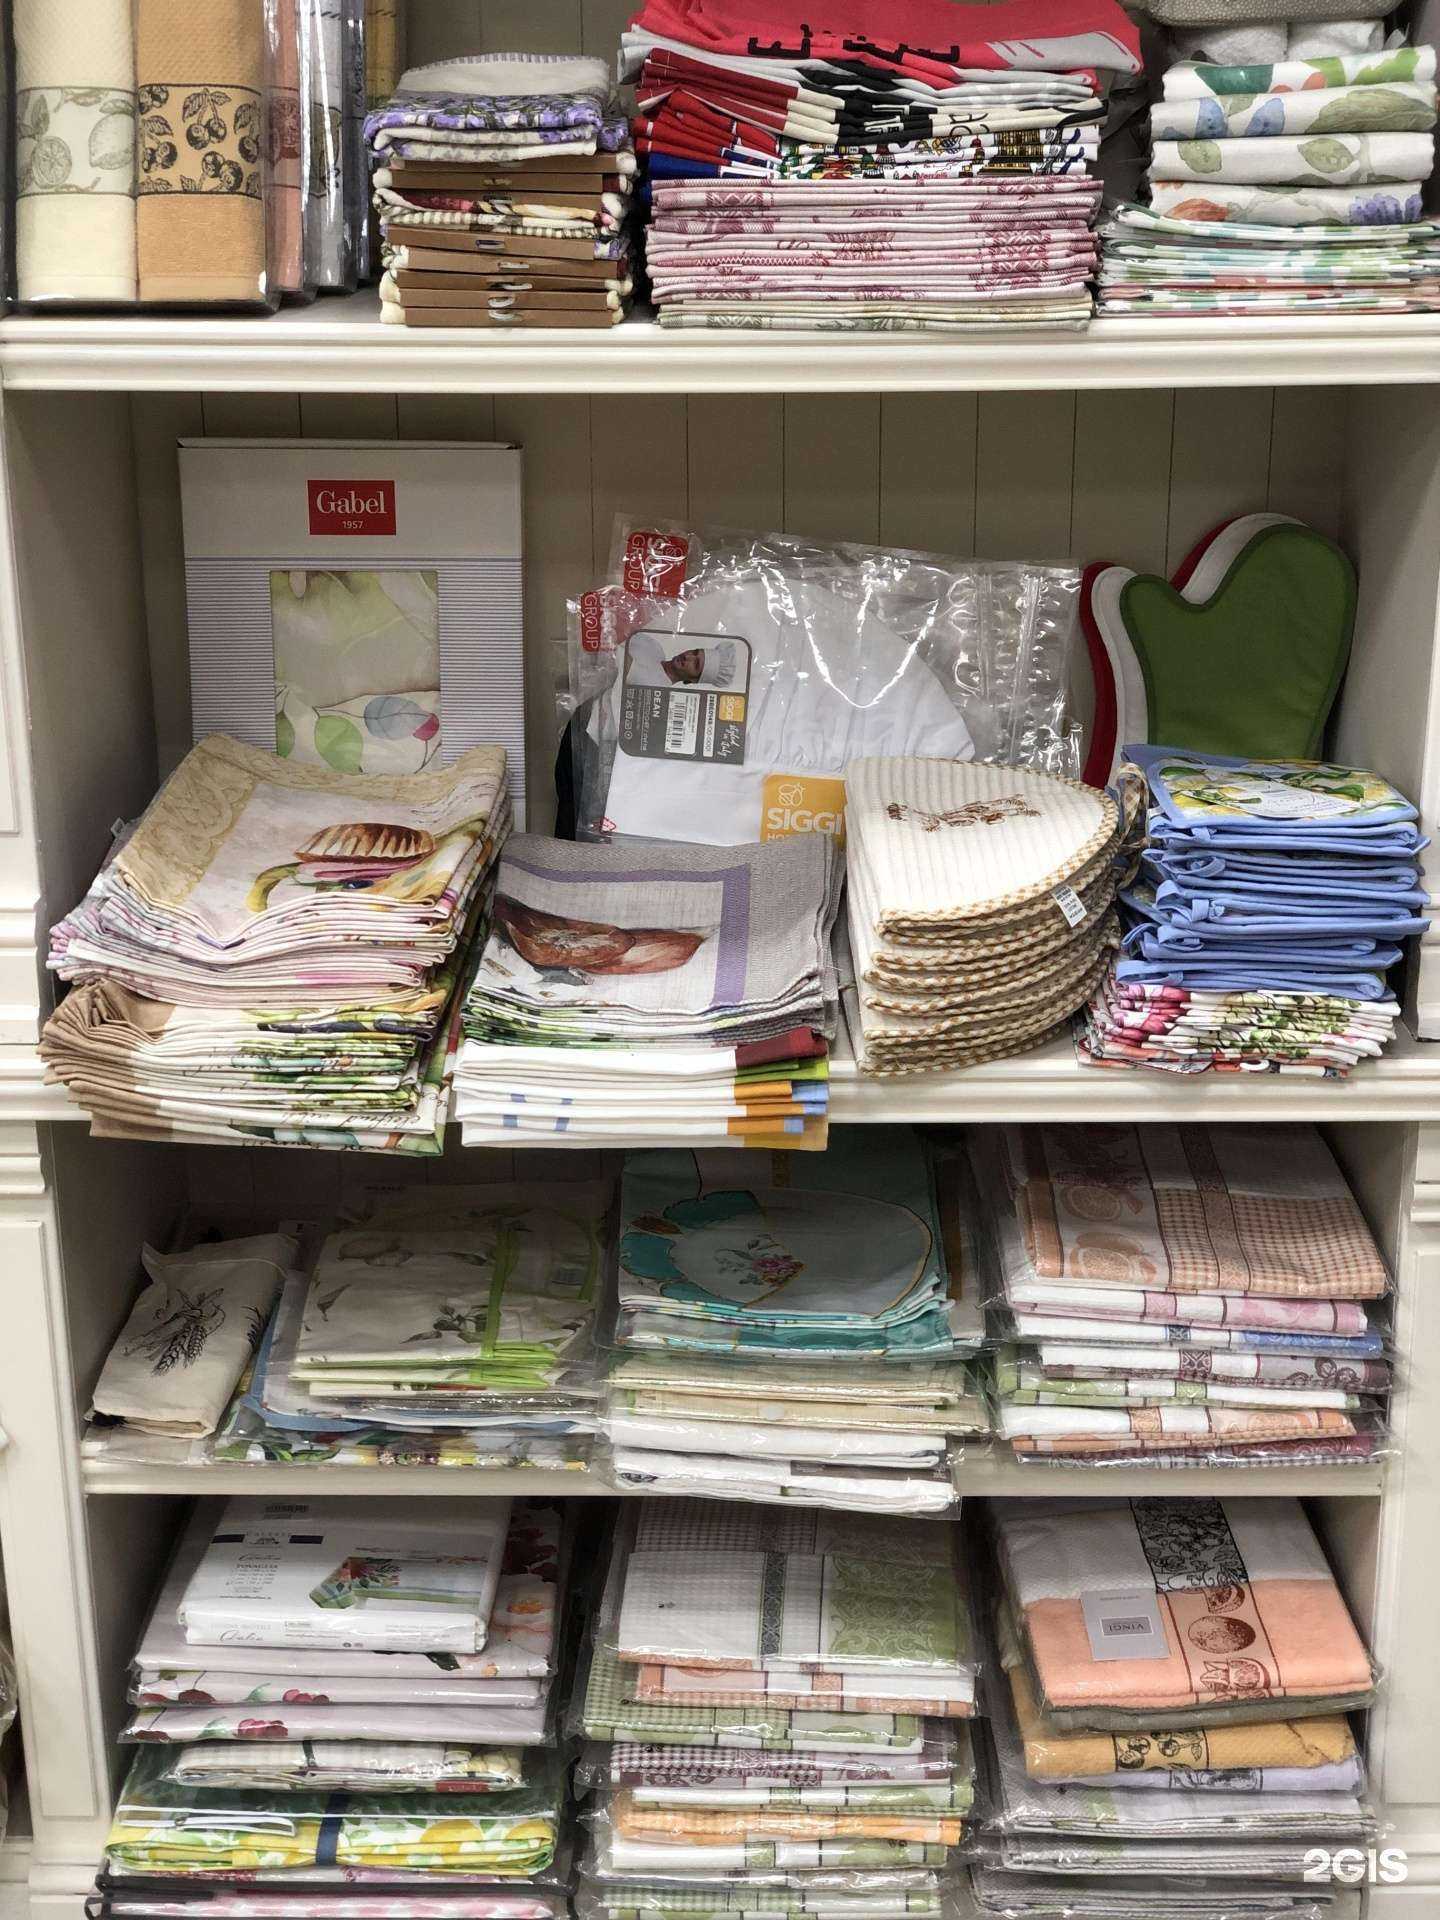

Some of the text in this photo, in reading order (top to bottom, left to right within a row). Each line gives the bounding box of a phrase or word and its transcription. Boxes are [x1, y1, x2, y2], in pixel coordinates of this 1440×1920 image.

[316, 490, 388, 514] Gabel
[342, 520, 364, 529] 1957
[627, 534, 646, 591] GROUP
[584, 594, 599, 649] GROUP
[652, 690, 662, 718] DEAN
[766, 807, 843, 835] SIGGI
[1109, 1623, 1144, 1632] VINGI
